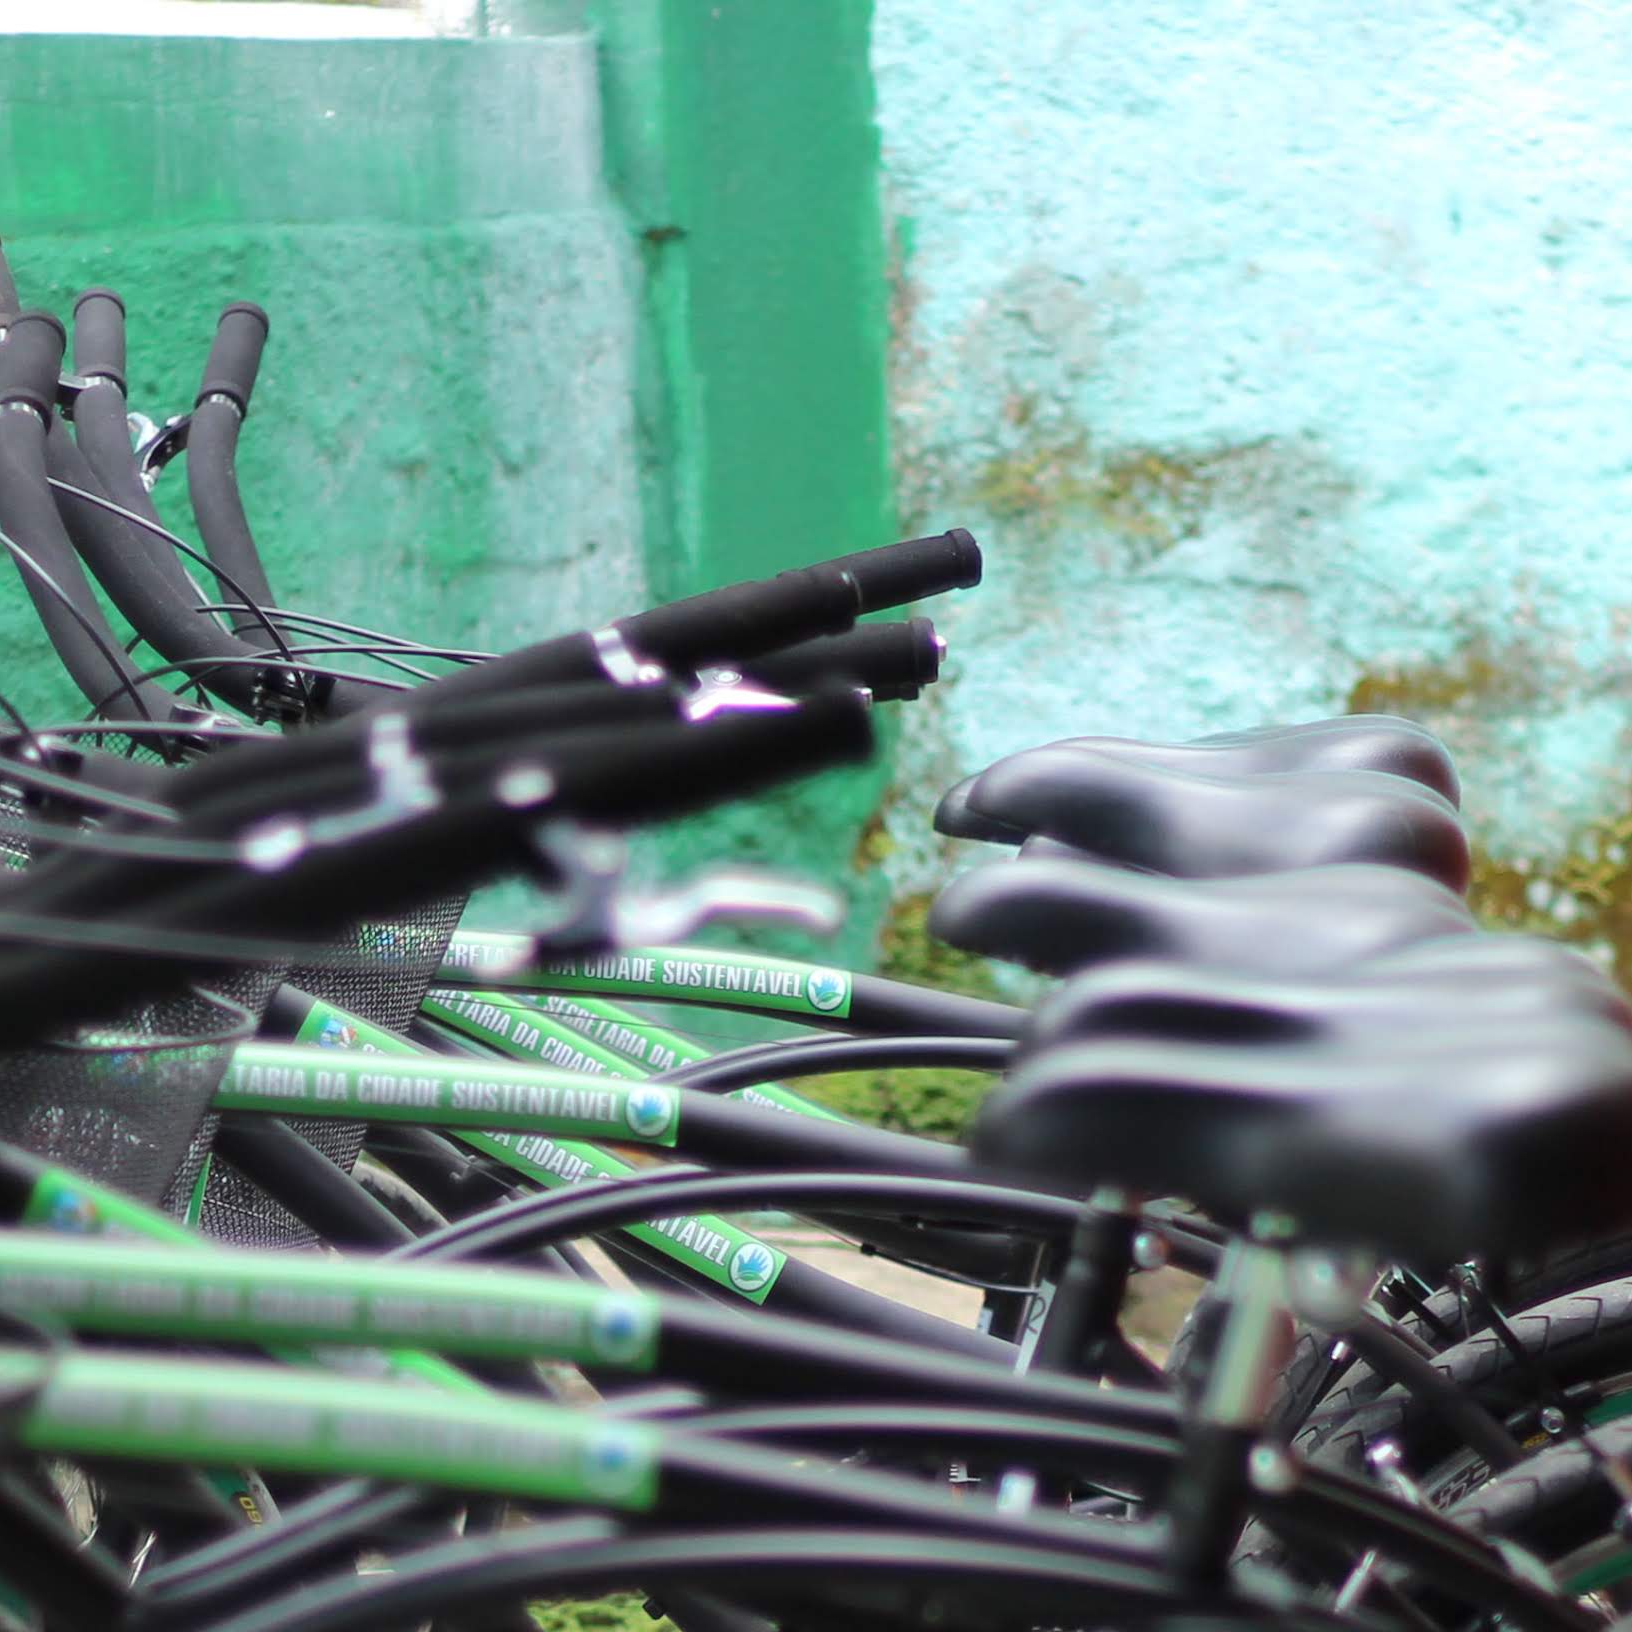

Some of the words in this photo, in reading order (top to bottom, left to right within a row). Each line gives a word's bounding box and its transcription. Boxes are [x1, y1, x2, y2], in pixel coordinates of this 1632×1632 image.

[583, 956, 656, 984] CIDADE
[511, 1021, 541, 1051] DA
[648, 1043, 677, 1071] DA
[315, 1070, 349, 1100] DA
[357, 1073, 442, 1108] CIDADE
